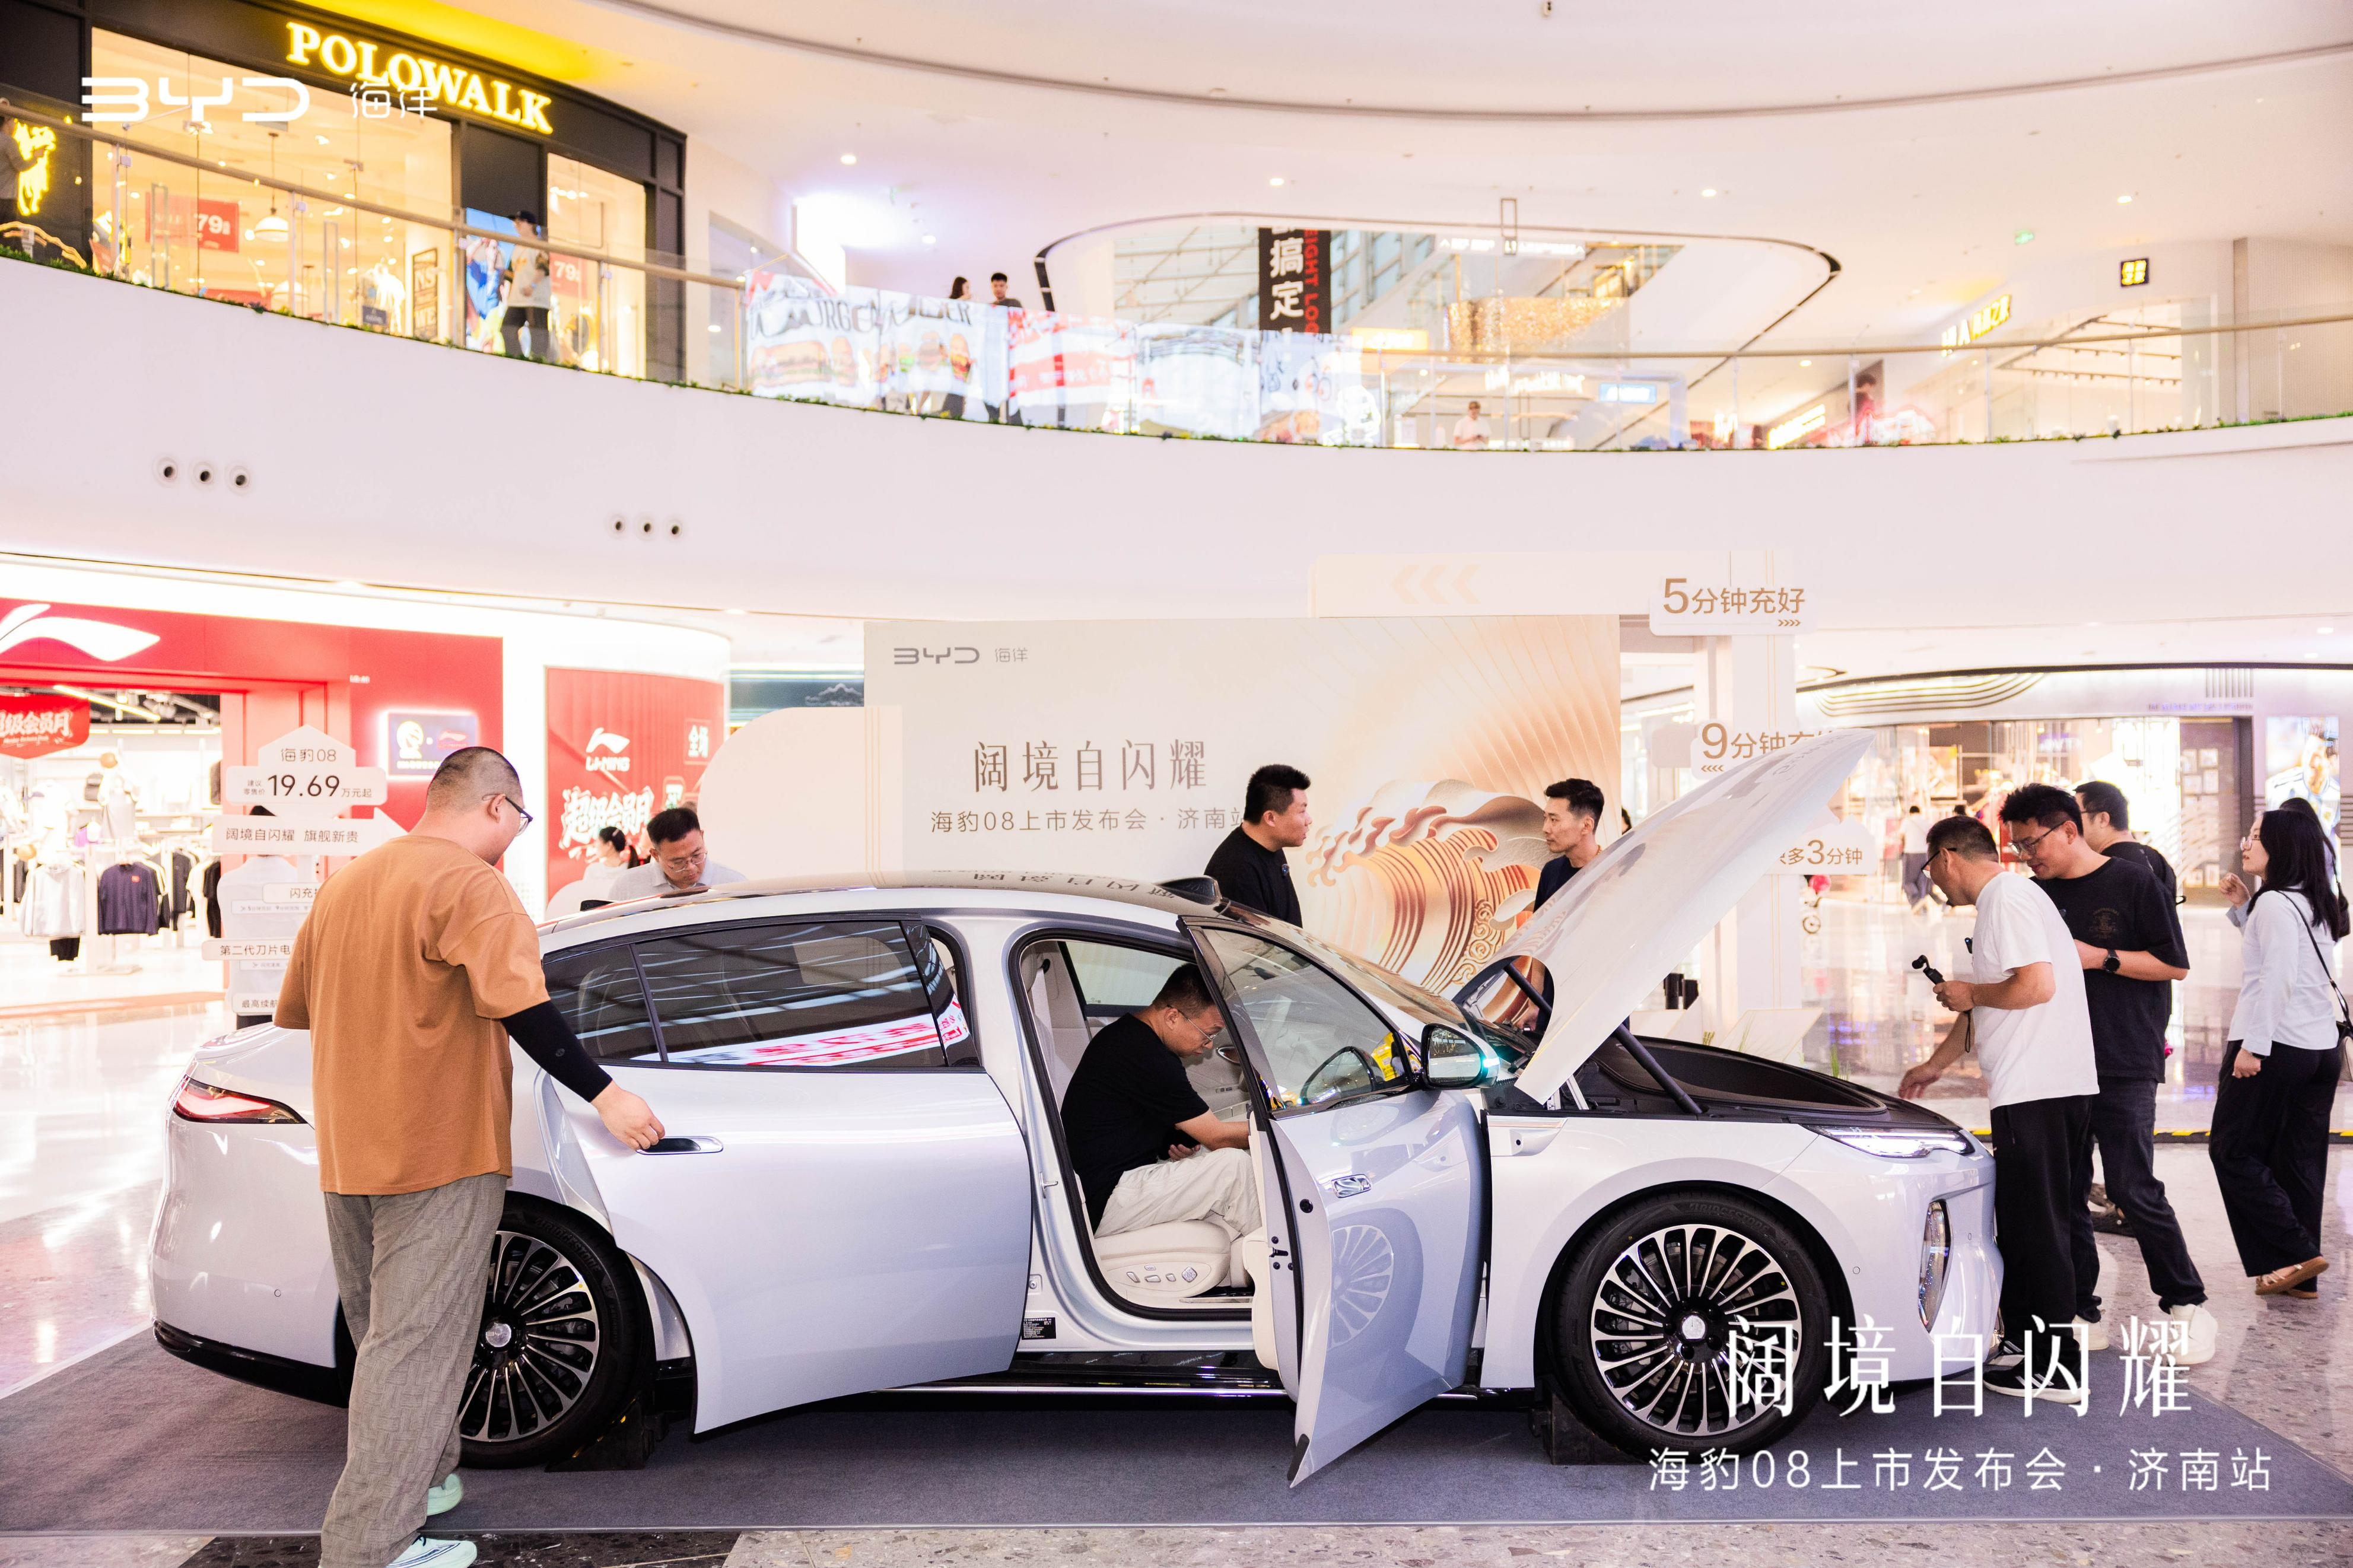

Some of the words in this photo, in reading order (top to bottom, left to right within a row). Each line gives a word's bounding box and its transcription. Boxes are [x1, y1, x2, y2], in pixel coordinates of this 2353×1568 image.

[287, 21, 553, 134] POLOWALK
[1663, 578, 1805, 615] 5分钟充好
[893, 647, 980, 665] BYD
[994, 647, 1028, 663] 海洋
[1701, 722, 1833, 760] 9分钟
[281, 748, 337, 762] 海豹08
[975, 739, 1207, 793] 阔境自闪耀
[243, 788, 265, 796] 零售价
[267, 774, 340, 797] 19.69
[341, 788, 373, 798] 万元起
[247, 779, 262, 787] 建议
[225, 828, 295, 841] 阔境自闪耀
[304, 829, 359, 843] 旗舰新贵
[290, 888, 317, 899] 闪充
[220, 944, 291, 956] 第二代刀片电
